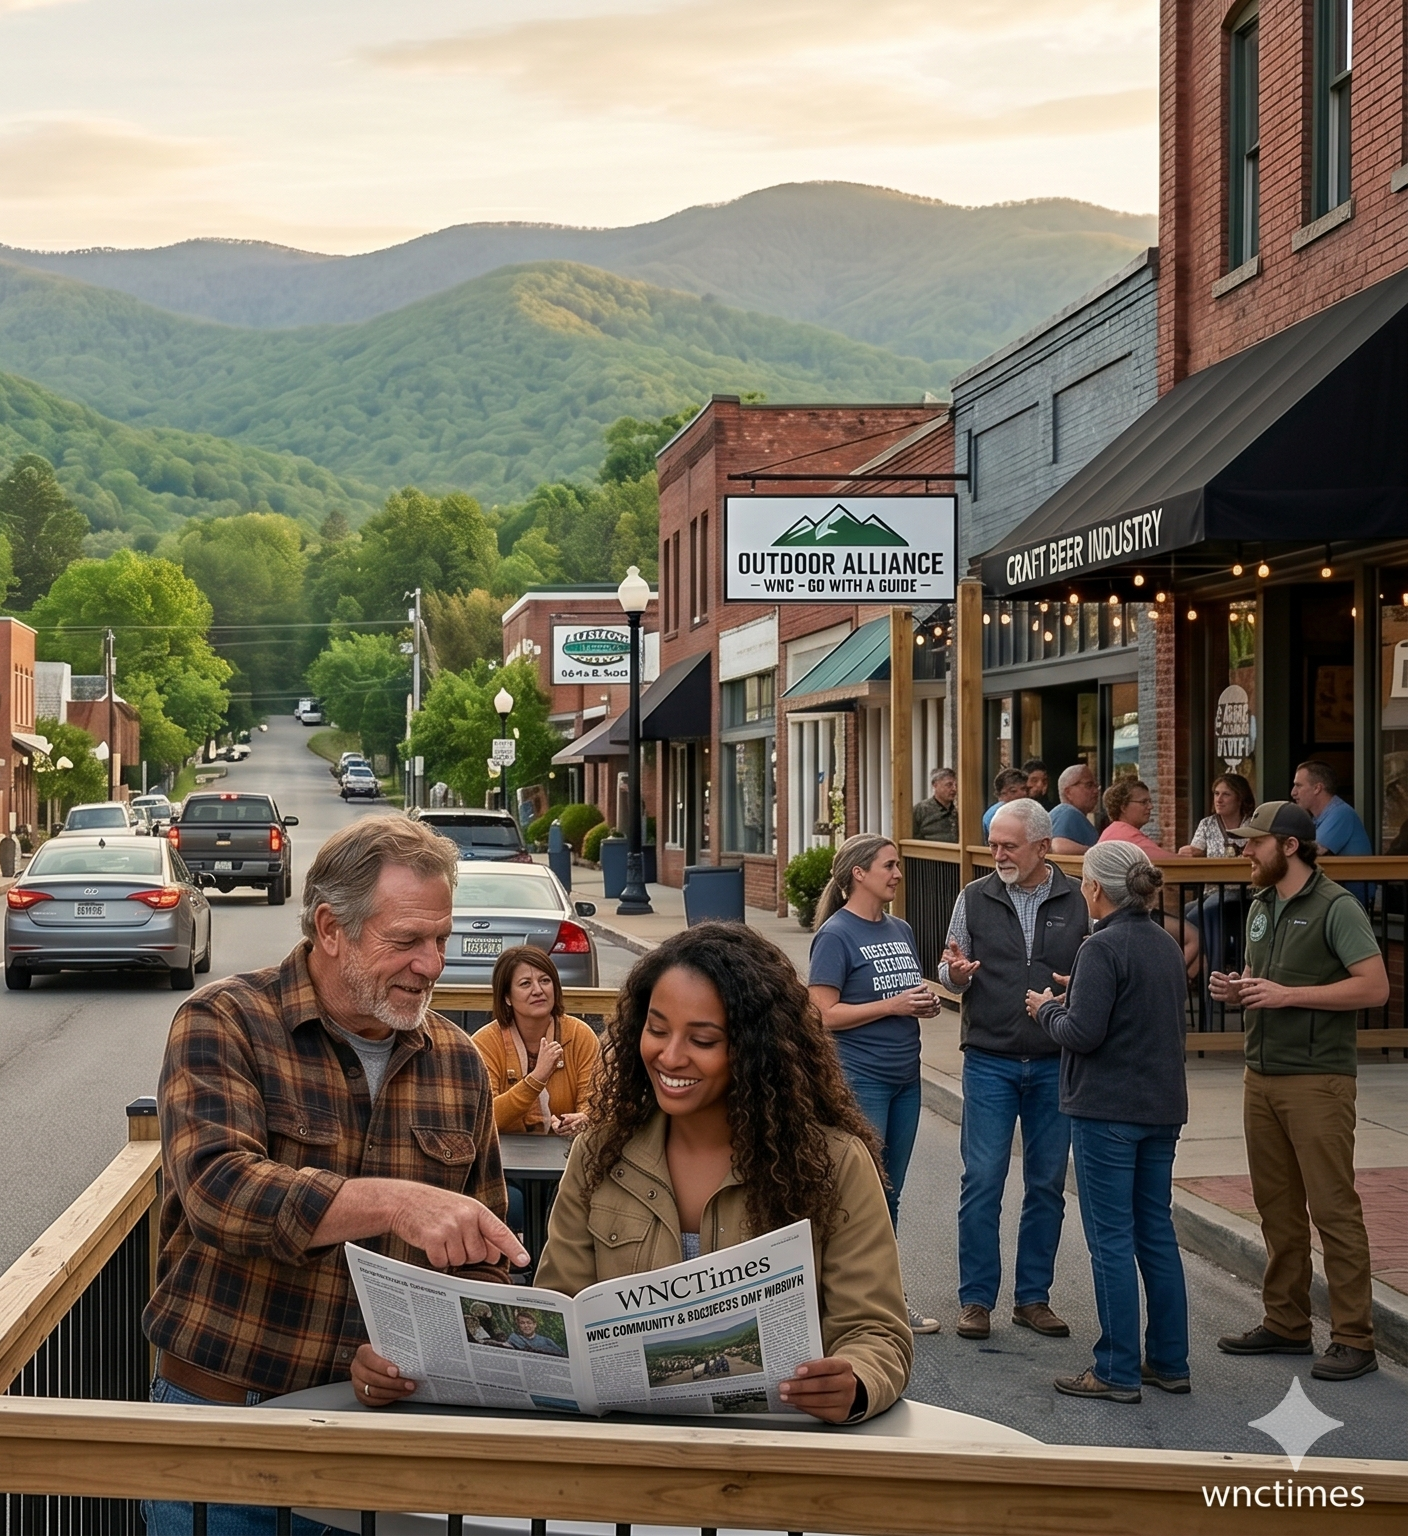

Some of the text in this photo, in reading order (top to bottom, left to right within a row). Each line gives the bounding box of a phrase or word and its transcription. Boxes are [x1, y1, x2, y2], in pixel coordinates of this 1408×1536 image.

[1006, 508, 1163, 586] CRAFT BEER INDUSTRY
[738, 552, 944, 575] OUTDOOR ALLIANCE
[763, 579, 795, 593] WNC
[808, 579, 825, 593] GO
[829, 579, 863, 593] WITH
[866, 579, 875, 593] A
[879, 579, 918, 593] GUIDE
[615, 1255, 771, 1311] WNCTimes
[586, 1327, 611, 1343] WNC
[612, 1315, 675, 1338] COMMUNITY
[677, 1312, 686, 1325] &
